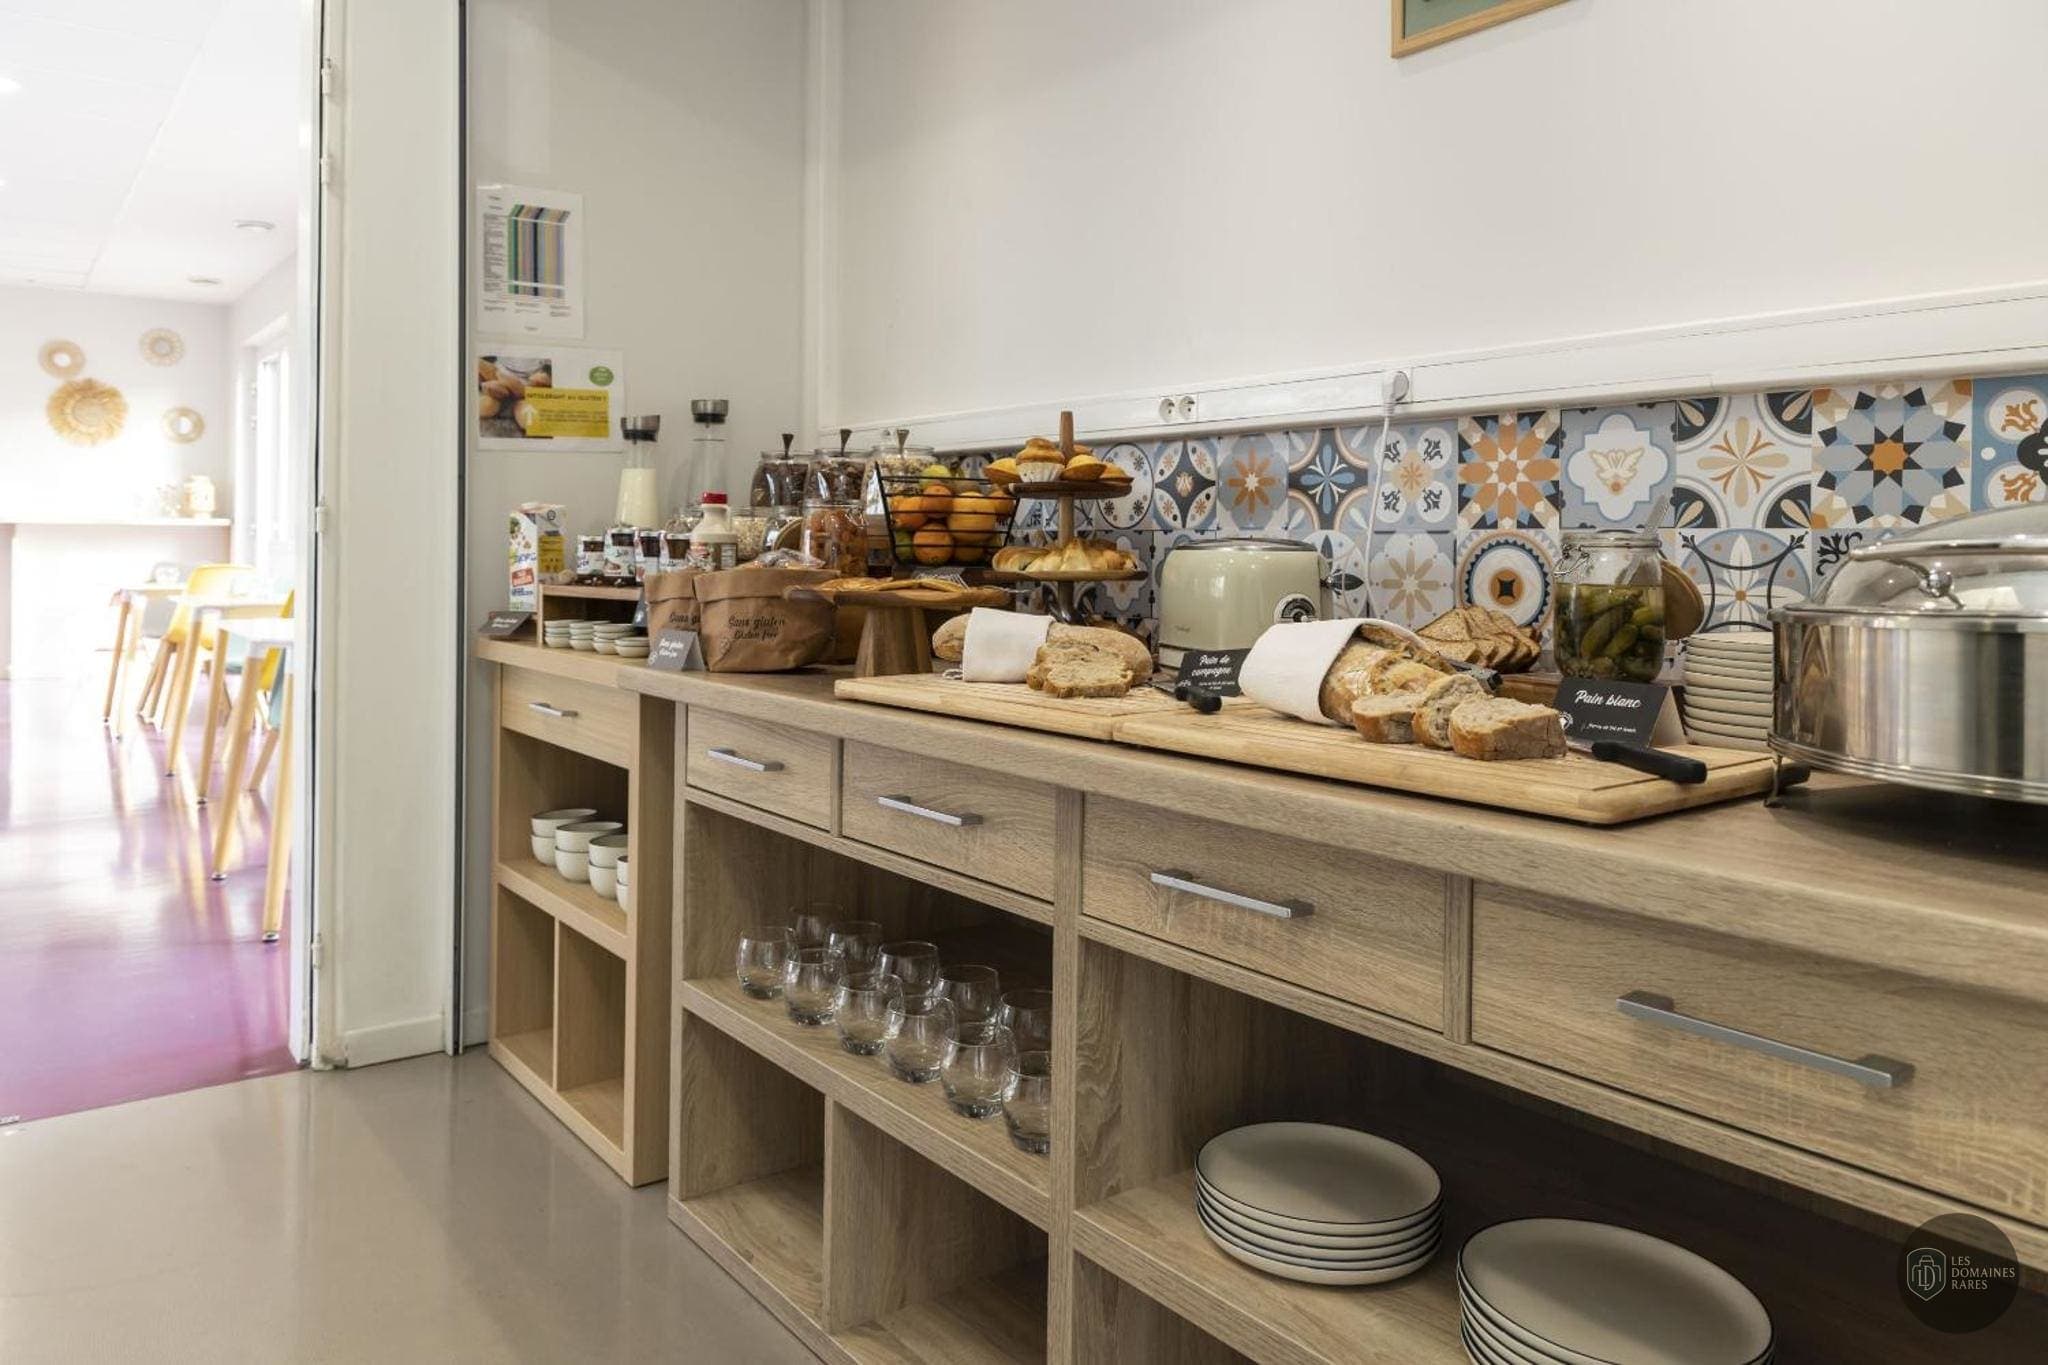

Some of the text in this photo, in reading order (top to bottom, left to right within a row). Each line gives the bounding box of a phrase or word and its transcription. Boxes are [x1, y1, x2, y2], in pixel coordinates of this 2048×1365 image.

[728, 616, 786, 629] Sans gluten
[1199, 654, 1230, 666] Pain de
[1191, 667, 1231, 677] campagne
[1574, 690, 1641, 708] Pain blanc
